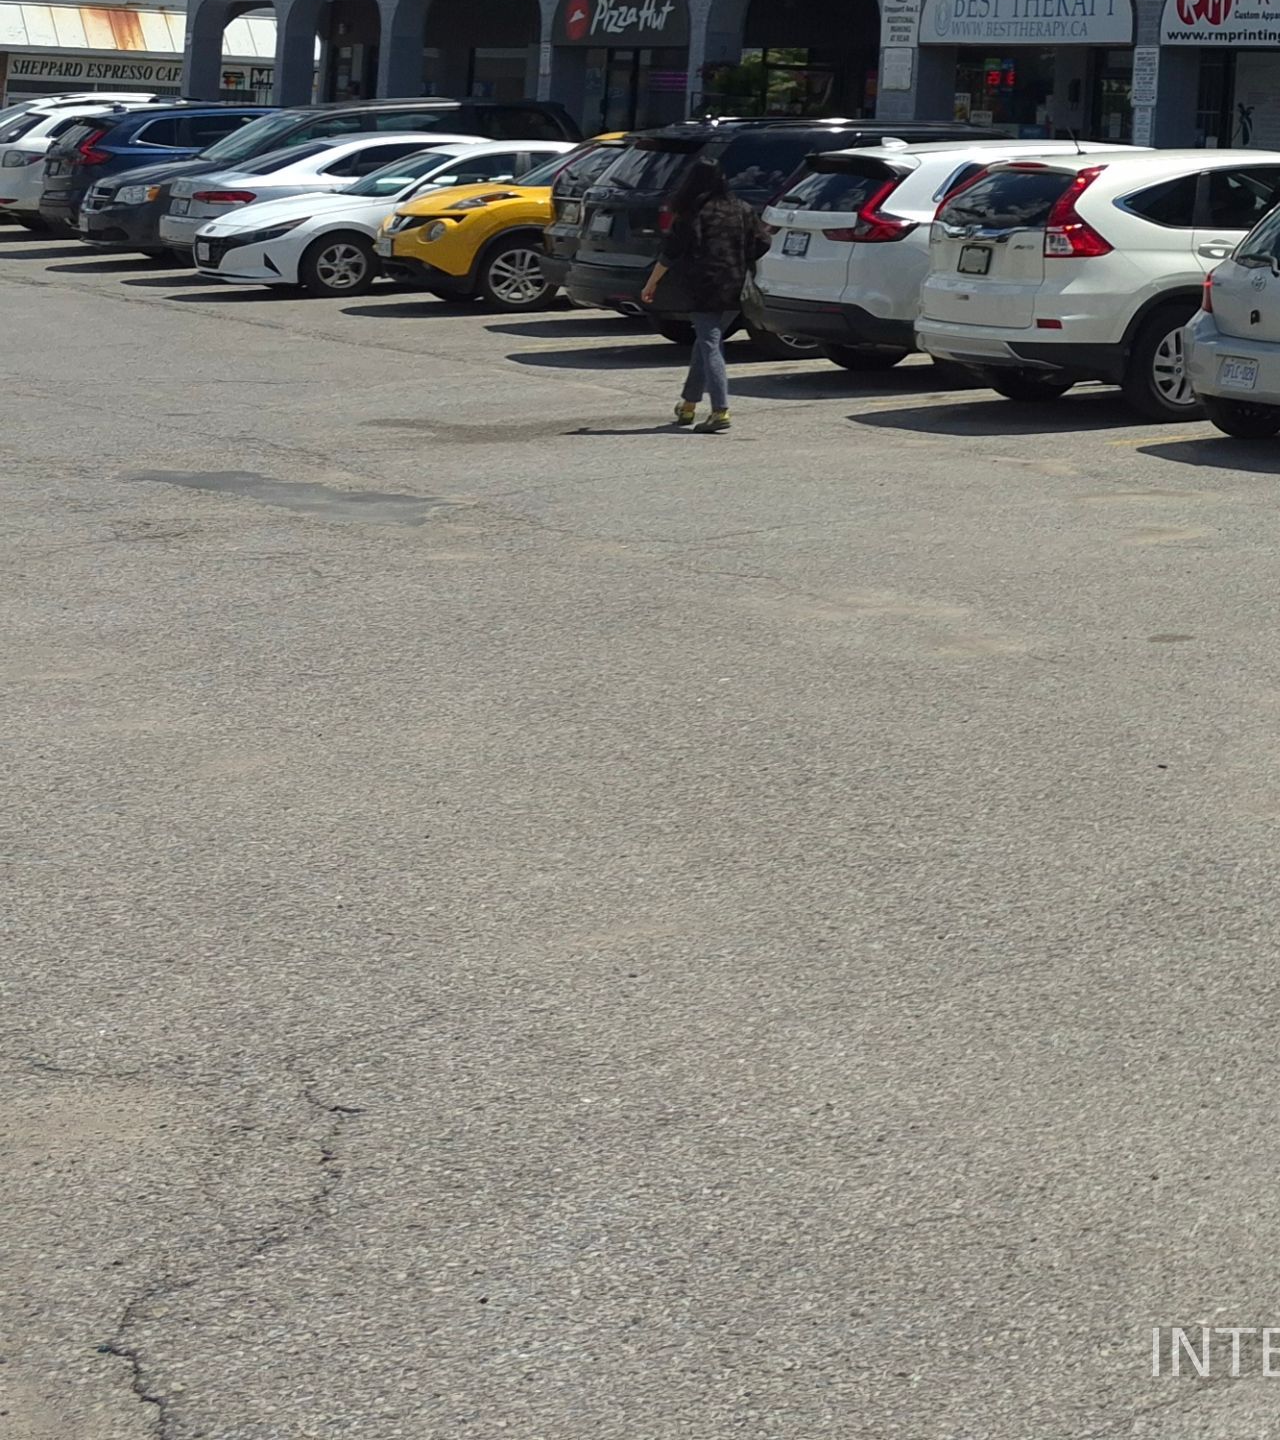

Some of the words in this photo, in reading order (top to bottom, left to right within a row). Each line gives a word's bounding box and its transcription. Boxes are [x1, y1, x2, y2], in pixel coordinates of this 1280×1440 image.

[1234, 10, 1260, 20] Custom
[950, 19, 1088, 38] WWW.BESTTHERAPY.CA
[11, 60, 84, 78] SHEPPARD
[86, 62, 154, 81] ESPRESSO
[155, 66, 184, 82] CAF
